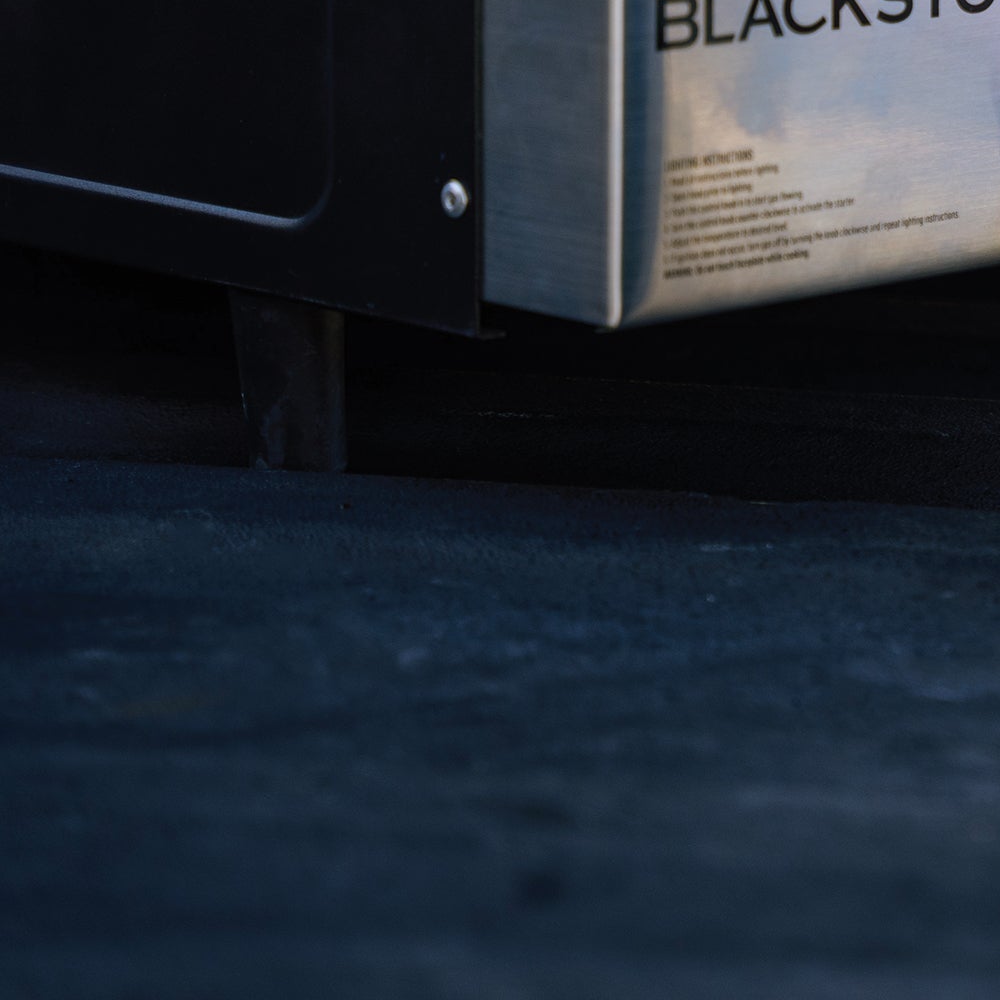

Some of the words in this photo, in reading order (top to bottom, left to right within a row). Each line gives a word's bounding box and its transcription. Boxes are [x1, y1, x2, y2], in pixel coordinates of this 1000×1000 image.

[699, 149, 753, 166] INSTRUCTIONS
[841, 223, 868, 235] clockwise
[870, 221, 880, 231] and
[881, 219, 900, 231] repeat
[902, 215, 924, 228] lighting
